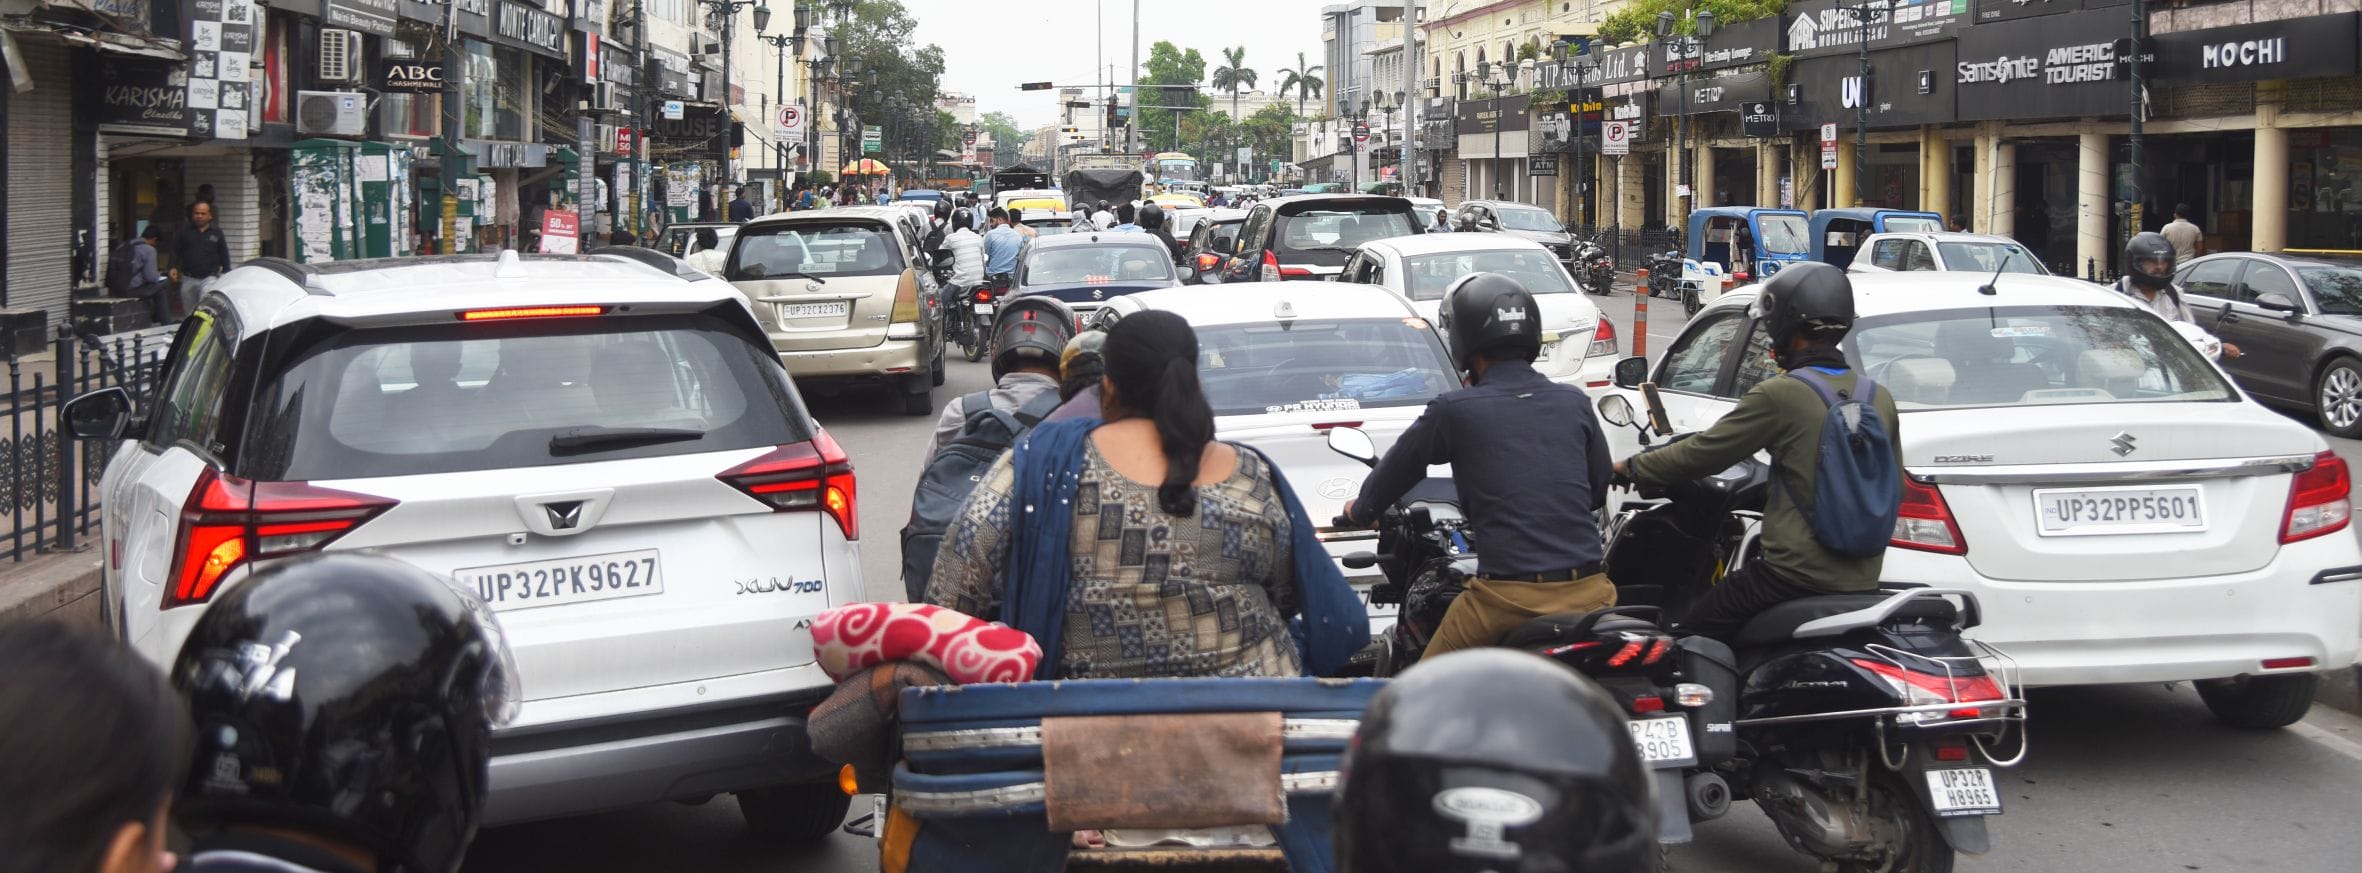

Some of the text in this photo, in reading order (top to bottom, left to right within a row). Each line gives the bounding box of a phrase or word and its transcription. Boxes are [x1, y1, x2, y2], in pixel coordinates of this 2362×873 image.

[332, 10, 393, 32] Naini Beauty Parlour
[500, 2, 527, 40] MONTE
[527, 10, 549, 48] CARLO
[1820, 0, 1888, 32] SUPERCETER
[2045, 43, 2114, 66] AMERIC
[2203, 38, 2284, 68] MOCHI
[388, 65, 442, 80] ABC
[1545, 53, 1629, 88] UP Asbstos Ltd.
[1958, 56, 2038, 84] Samsonite
[2045, 62, 2117, 84] TOURIST
[387, 80, 442, 88] CHASHMEWALE
[1842, 76, 1862, 108] UN
[104, 86, 185, 108] KARISMA
[1571, 102, 1602, 113] Kbila
[1744, 113, 1775, 122] METRO
[2056, 495, 2198, 522] UP32PP5601
[478, 557, 657, 602] UP32PK9627
[1630, 720, 1678, 738] P42B
[1635, 740, 1681, 759] 8905
[1947, 788, 1991, 807] H8965
